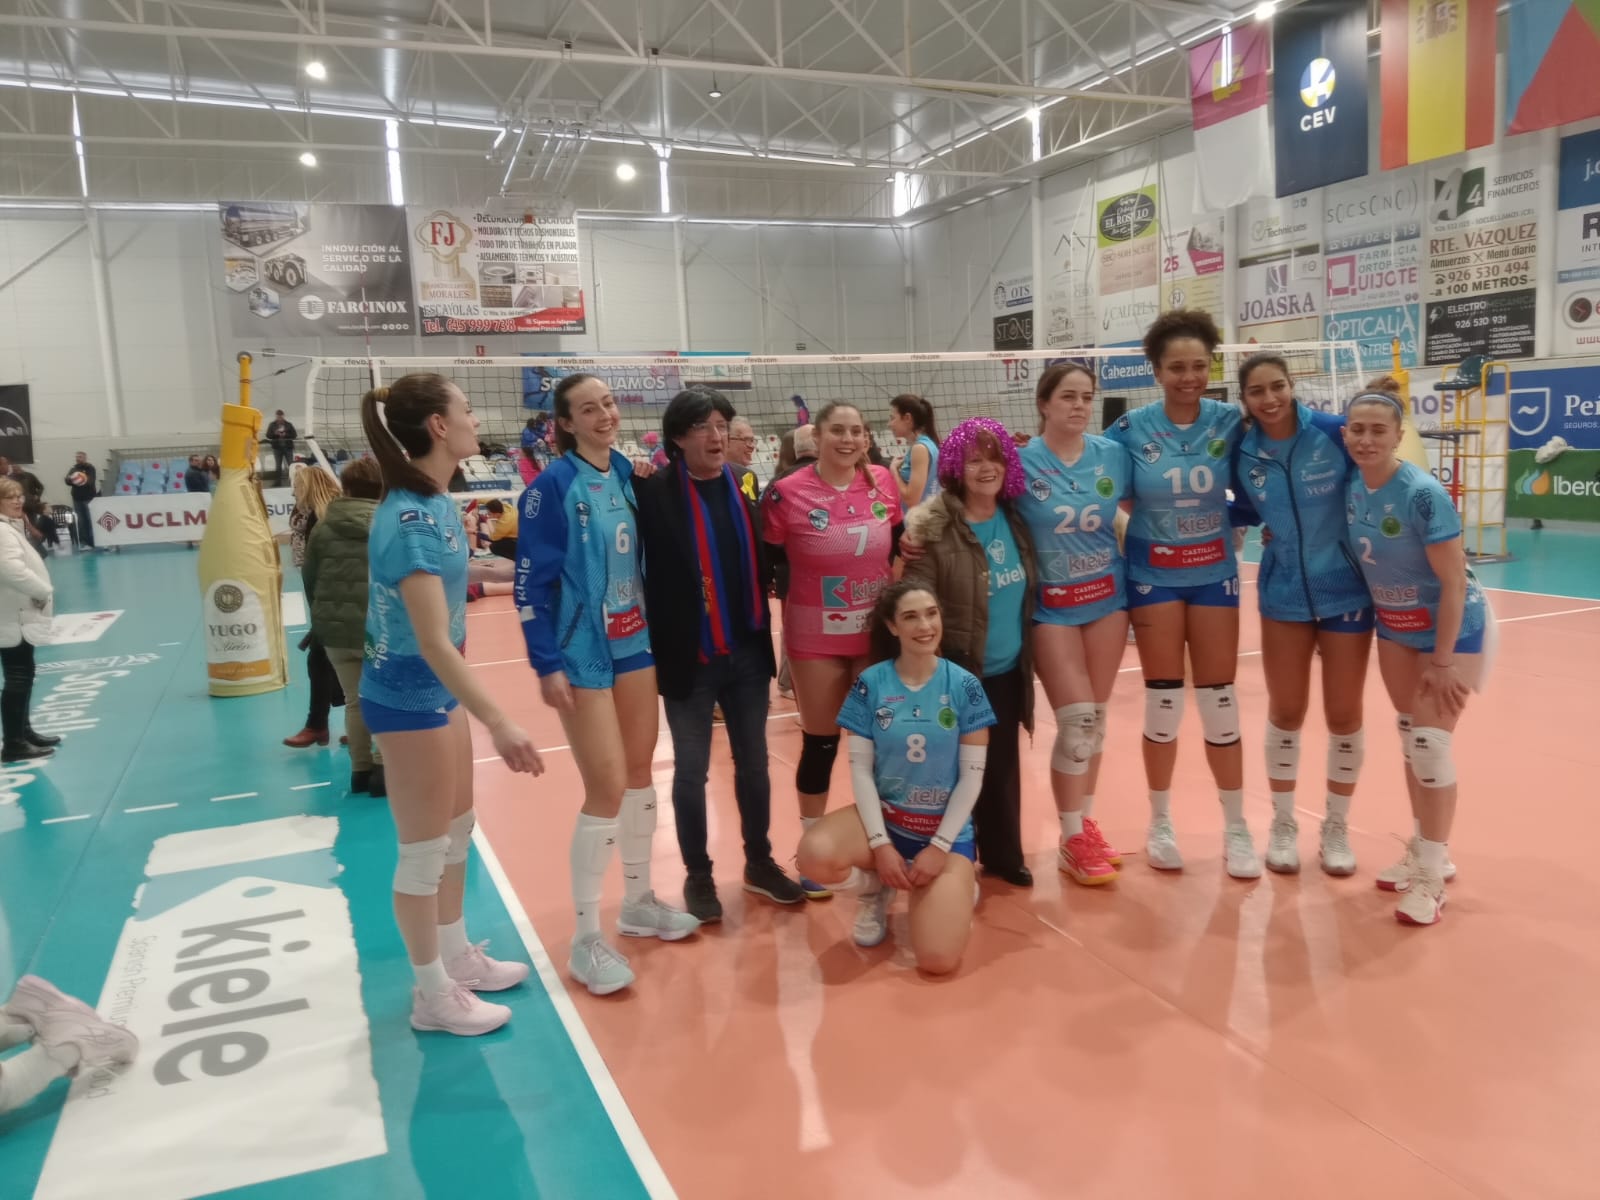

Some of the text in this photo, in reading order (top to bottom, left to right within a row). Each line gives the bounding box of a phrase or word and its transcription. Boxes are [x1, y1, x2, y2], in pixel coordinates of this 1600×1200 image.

[1300, 106, 1336, 132] CEV
[1493, 169, 1535, 186] SERVICIOS
[1487, 180, 1540, 200] FINANCIEROS
[477, 227, 509, 236] MOLDURAS
[508, 228, 513, 237] Y
[514, 228, 535, 237] TECHOS
[1105, 218, 1115, 229] EL
[430, 221, 457, 246] FJ
[1430, 223, 1537, 254] RTE. VÁZQUEZ
[388, 245, 403, 253] AL
[479, 240, 495, 249] TODO
[495, 240, 509, 249] TIPO
[509, 240, 518, 249] DE
[546, 241, 554, 250] EN
[554, 241, 577, 250] PLADUR
[322, 254, 403, 263] SERVICO DE LA
[480, 253, 518, 262] AISLAMIENTOS
[1163, 255, 1180, 273] 25
[1430, 243, 1536, 269] Almuerzos Menú diario
[322, 264, 368, 273] CALIDAD
[1359, 257, 1417, 274] ORTOPDIA
[1448, 261, 1529, 283] 926 530 494
[428, 290, 471, 299] MORALES
[1446, 283, 1468, 295] 100
[327, 300, 408, 314] FARCINOX
[423, 303, 480, 317] ESCAYOLAS
[1240, 291, 1316, 321] JOASRA
[1447, 301, 1487, 314] ELECTRO
[424, 318, 445, 333] Tel.
[446, 317, 467, 333] 645
[469, 318, 491, 333] 999
[494, 318, 517, 333] 738
[1455, 314, 1507, 329] 926 530 931
[1340, 340, 1416, 359] CONTREAS
[453, 358, 493, 366] rfevb.com
[557, 357, 594, 365] rfevb.com
[1162, 465, 1214, 494] 10
[125, 510, 207, 530] UCLM
[1053, 504, 1101, 534] 26
[1176, 511, 1222, 533] kiele
[616, 522, 630, 555] 6
[847, 525, 869, 557] 7
[1359, 536, 1377, 566] 2
[1068, 550, 1112, 572] kiele
[515, 557, 531, 601] kiele
[1222, 577, 1239, 596] 10
[208, 622, 257, 637] YUGO
[906, 733, 926, 763] 8
[153, 909, 312, 1086] kiele
